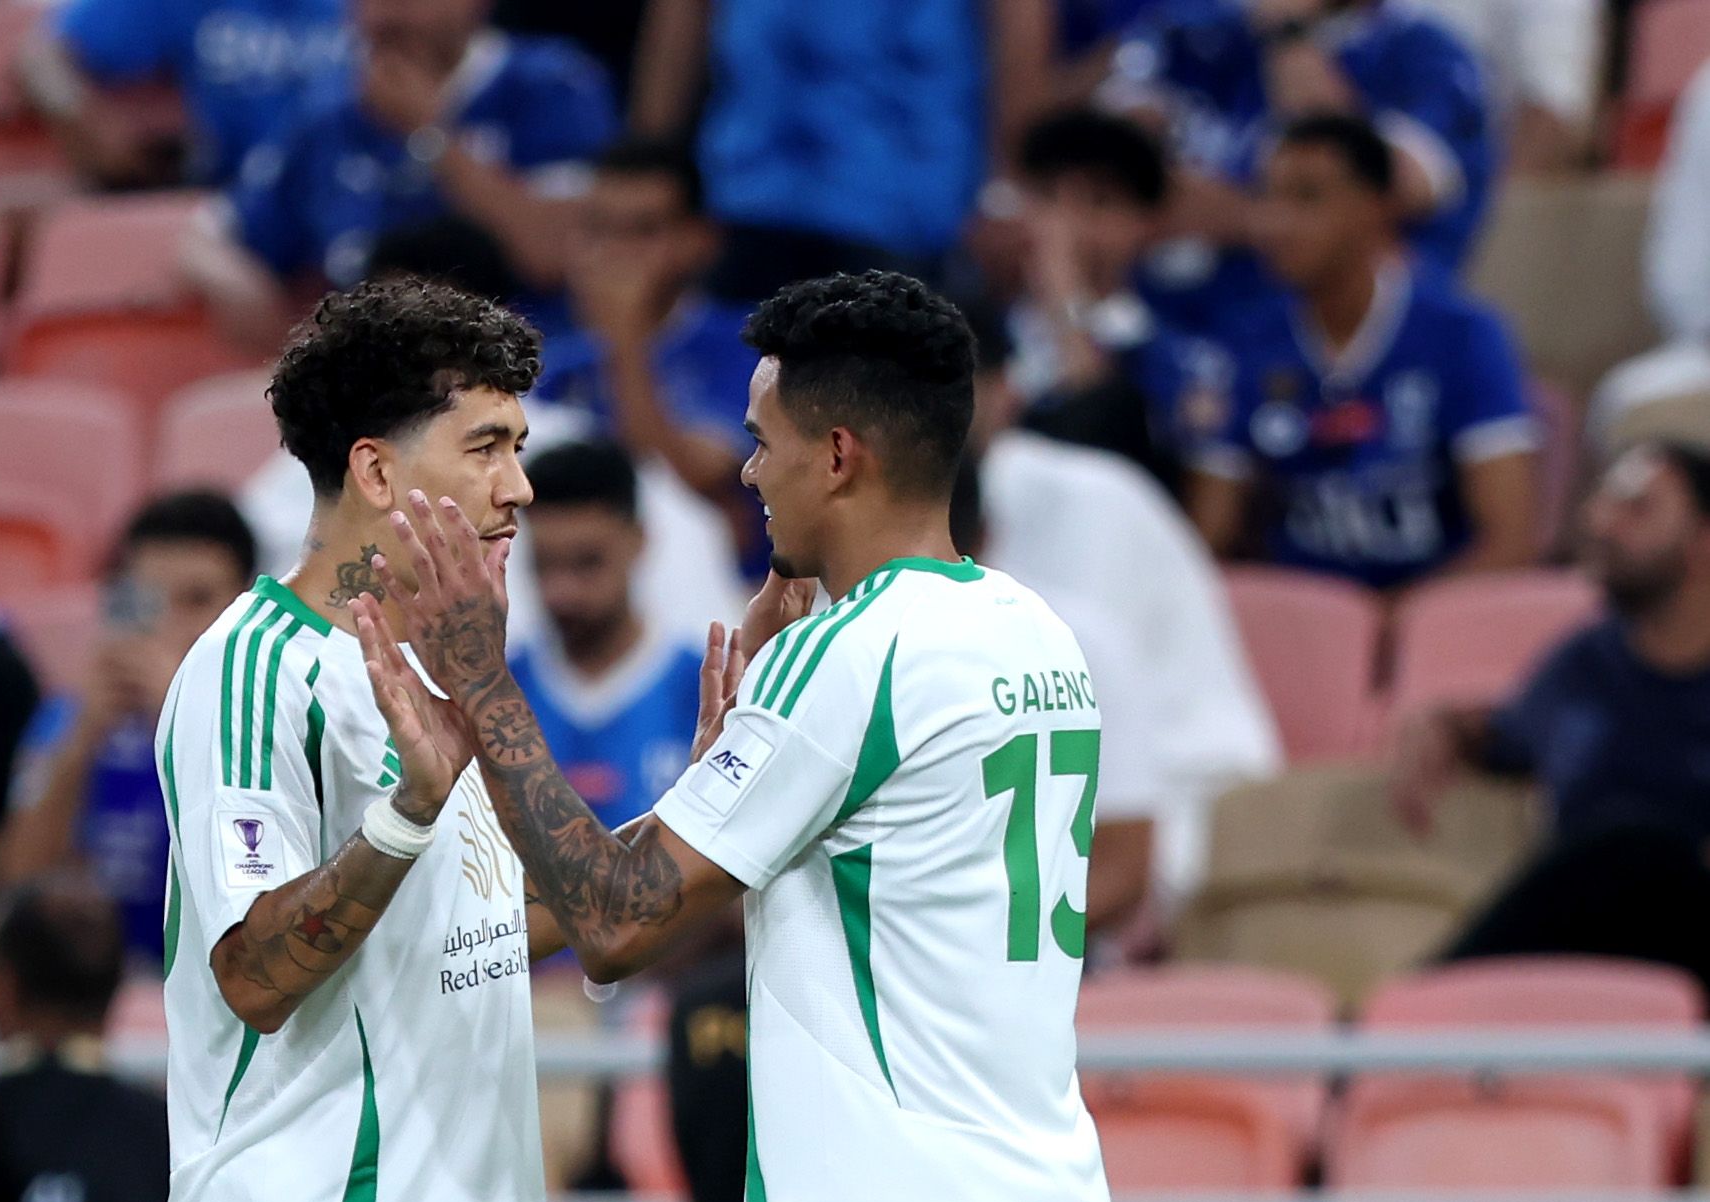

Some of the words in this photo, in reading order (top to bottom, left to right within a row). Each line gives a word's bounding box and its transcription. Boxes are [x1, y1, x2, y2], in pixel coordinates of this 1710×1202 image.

[711, 750, 754, 780] AFC
[981, 729, 1101, 962] 13
[440, 959, 480, 995] Red
